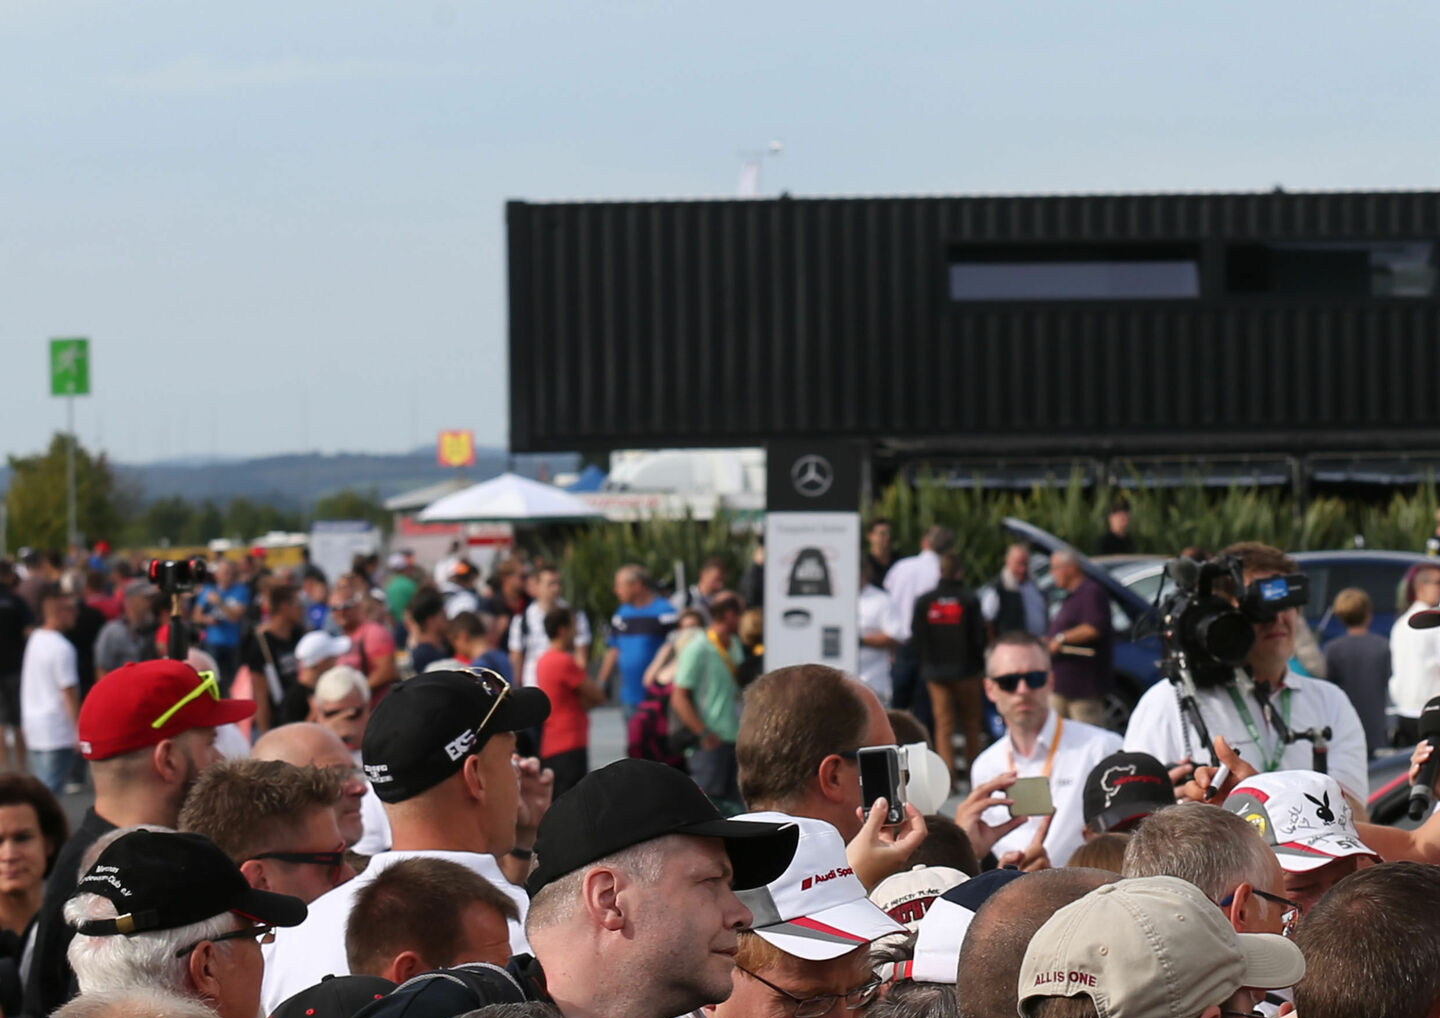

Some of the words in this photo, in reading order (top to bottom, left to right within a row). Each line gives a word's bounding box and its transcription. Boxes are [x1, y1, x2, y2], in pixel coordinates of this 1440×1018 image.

[815, 869, 836, 884] Audi
[1034, 972, 1052, 987] ALL
[1053, 971, 1065, 983] IS
[1069, 971, 1097, 988] ONE
